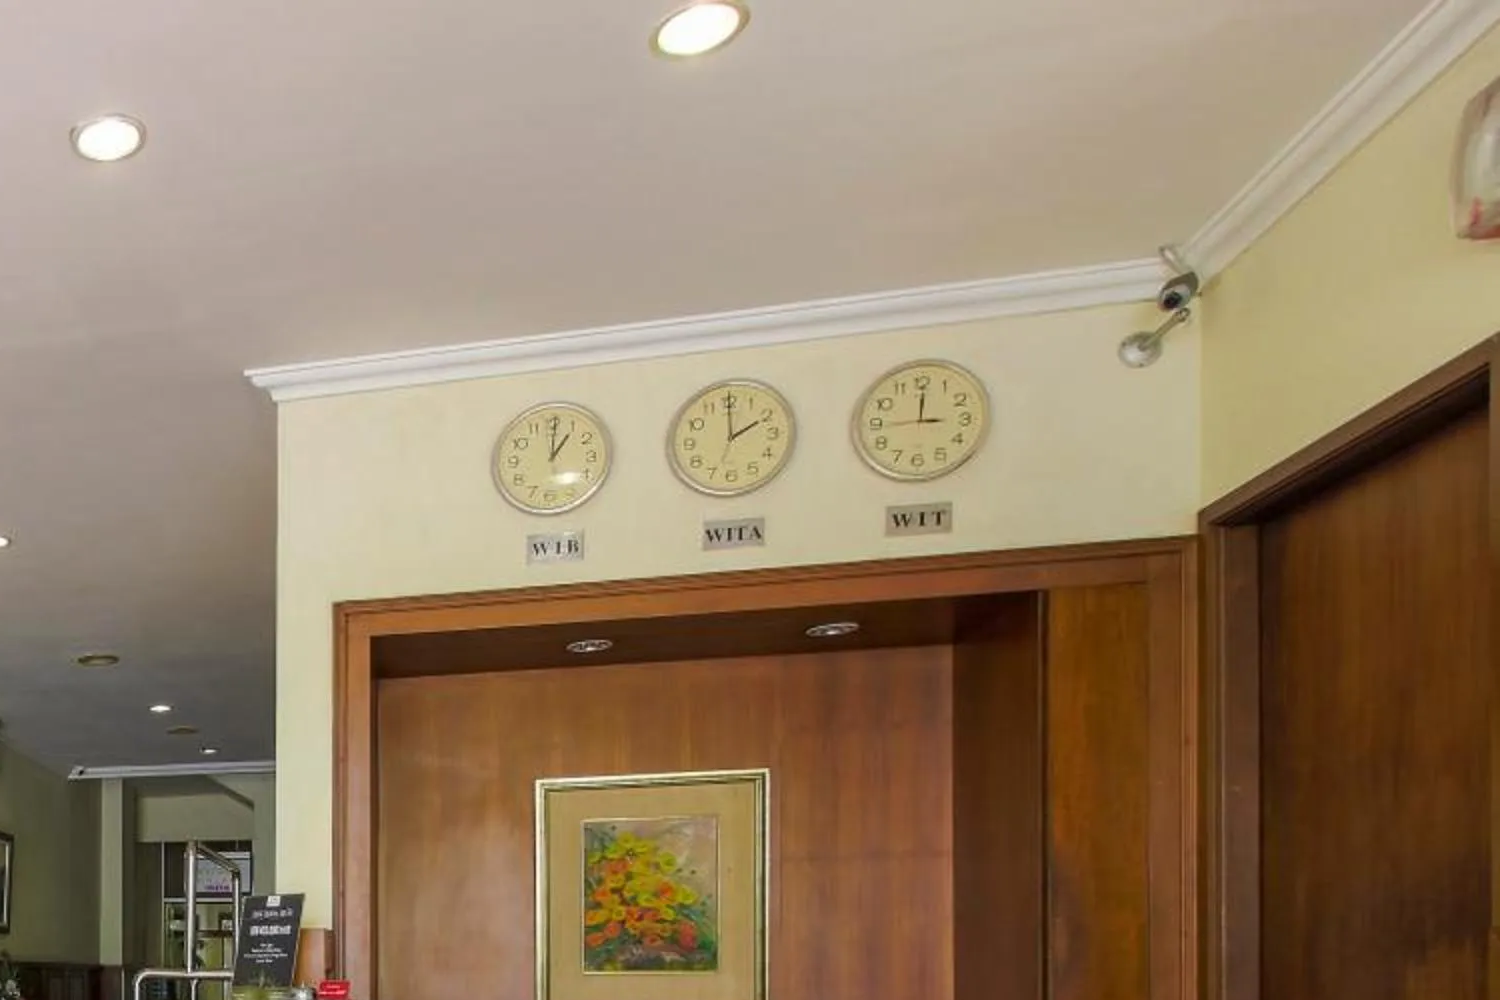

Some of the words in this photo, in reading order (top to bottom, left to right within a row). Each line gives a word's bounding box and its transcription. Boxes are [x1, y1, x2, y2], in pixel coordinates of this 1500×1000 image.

[894, 382, 905, 395] 11
[914, 376, 931, 390] 12
[942, 379, 947, 393] 1
[877, 397, 893, 411] 10
[953, 392, 967, 407] 2
[704, 402, 715, 414] 11
[762, 408, 773, 422] 2
[958, 411, 971, 427] 3
[529, 423, 538, 434] 11
[689, 417, 705, 431] 10
[869, 417, 882, 430] 9
[581, 432, 592, 445] 2
[767, 427, 779, 440] 3
[951, 432, 964, 445] 4
[514, 437, 529, 450] 10
[683, 438, 695, 450] 9
[875, 435, 887, 450] 8
[586, 450, 596, 462] 3
[762, 447, 773, 460] 4
[892, 449, 903, 463] 7
[911, 453, 924, 467] 6
[934, 447, 947, 462] 5
[507, 455, 519, 468] 9
[690, 455, 702, 468] 8
[707, 467, 717, 480] 7
[747, 462, 759, 475] 5
[513, 473, 524, 486] 8
[725, 470, 738, 482] 6
[527, 485, 538, 498] 7
[892, 509, 947, 528] WIT
[705, 525, 762, 542] WITA
[532, 539, 579, 556] WIB
